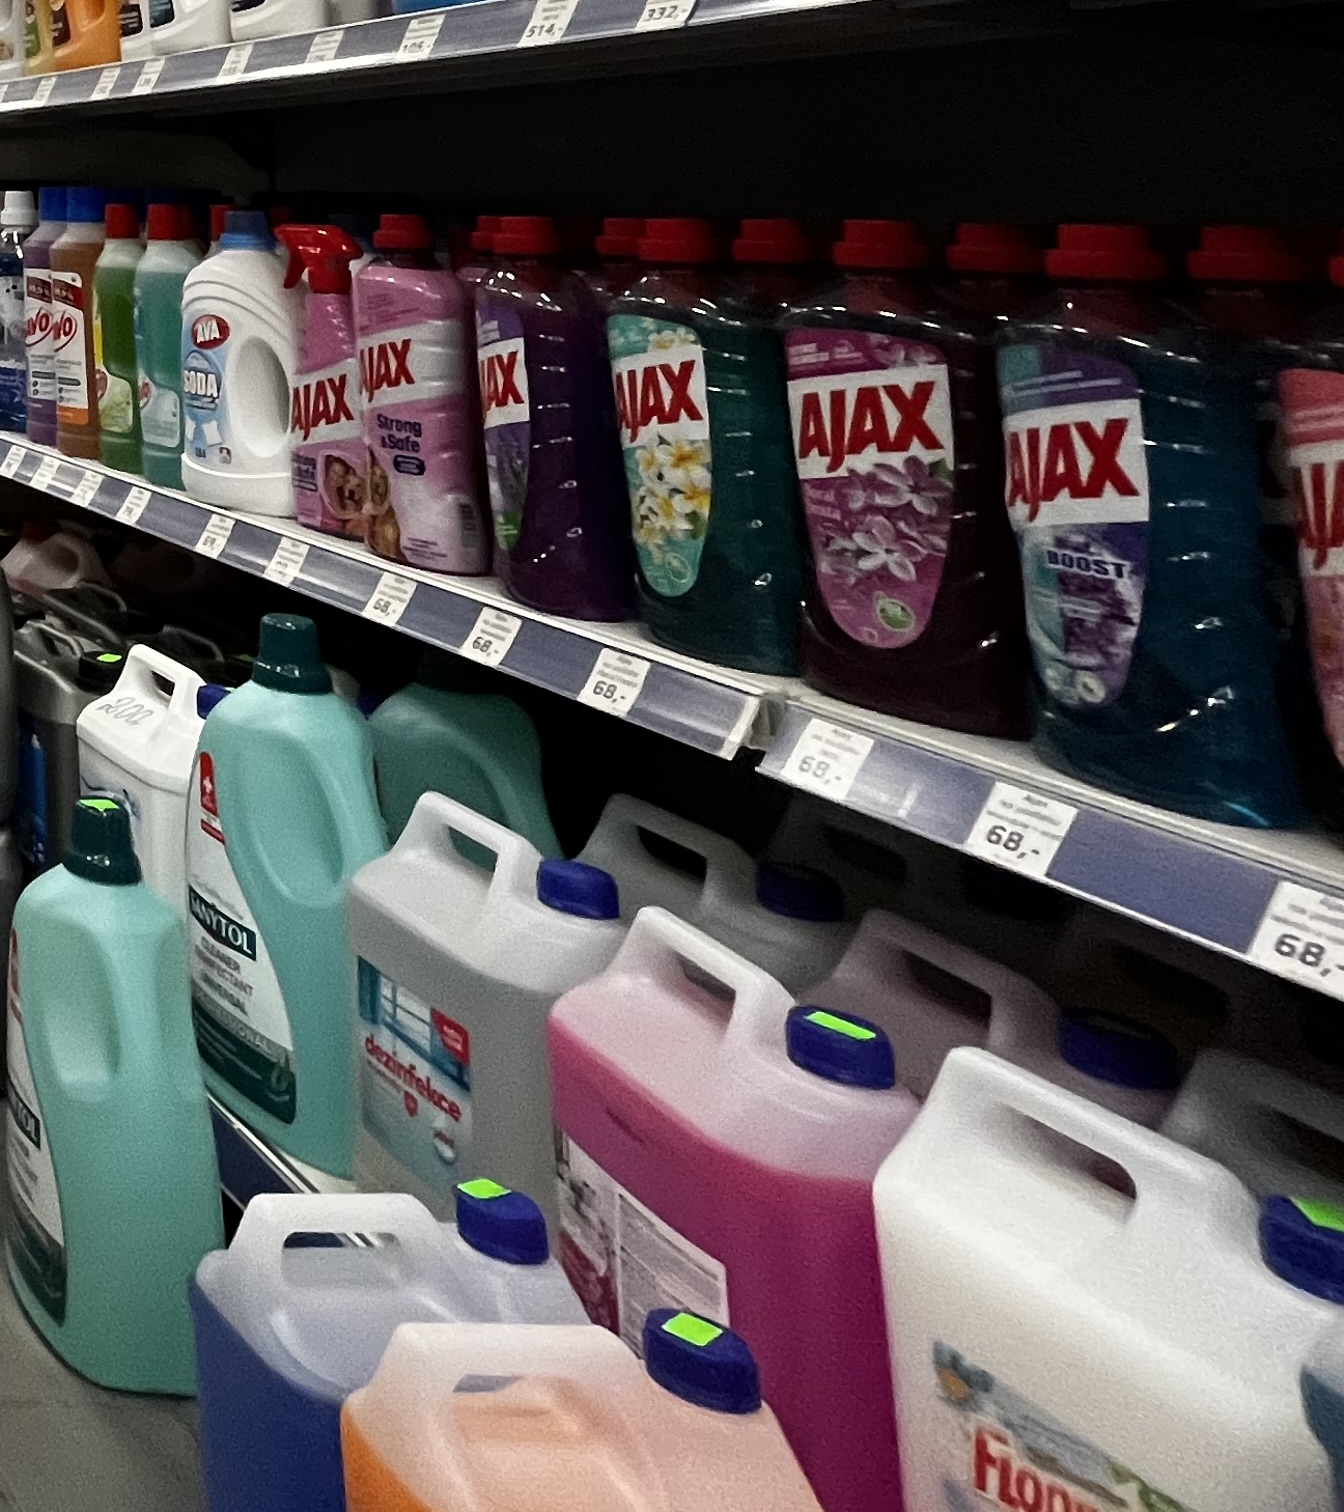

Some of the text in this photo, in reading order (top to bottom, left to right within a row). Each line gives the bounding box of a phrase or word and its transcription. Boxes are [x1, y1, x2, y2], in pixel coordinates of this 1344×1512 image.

[183, 368, 219, 399] SODA
[615, 358, 701, 445] AJAX
[290, 374, 355, 441] AJAX
[376, 412, 422, 441] Strong
[798, 381, 945, 474] AJAX
[1007, 417, 1141, 523] AJAX
[1046, 548, 1131, 580] BOOST
[797, 754, 843, 785] 68,-
[984, 825, 1041, 860] 68,-
[1273, 932, 1344, 978] 68,-
[364, 1033, 462, 1123] dezinfekce
